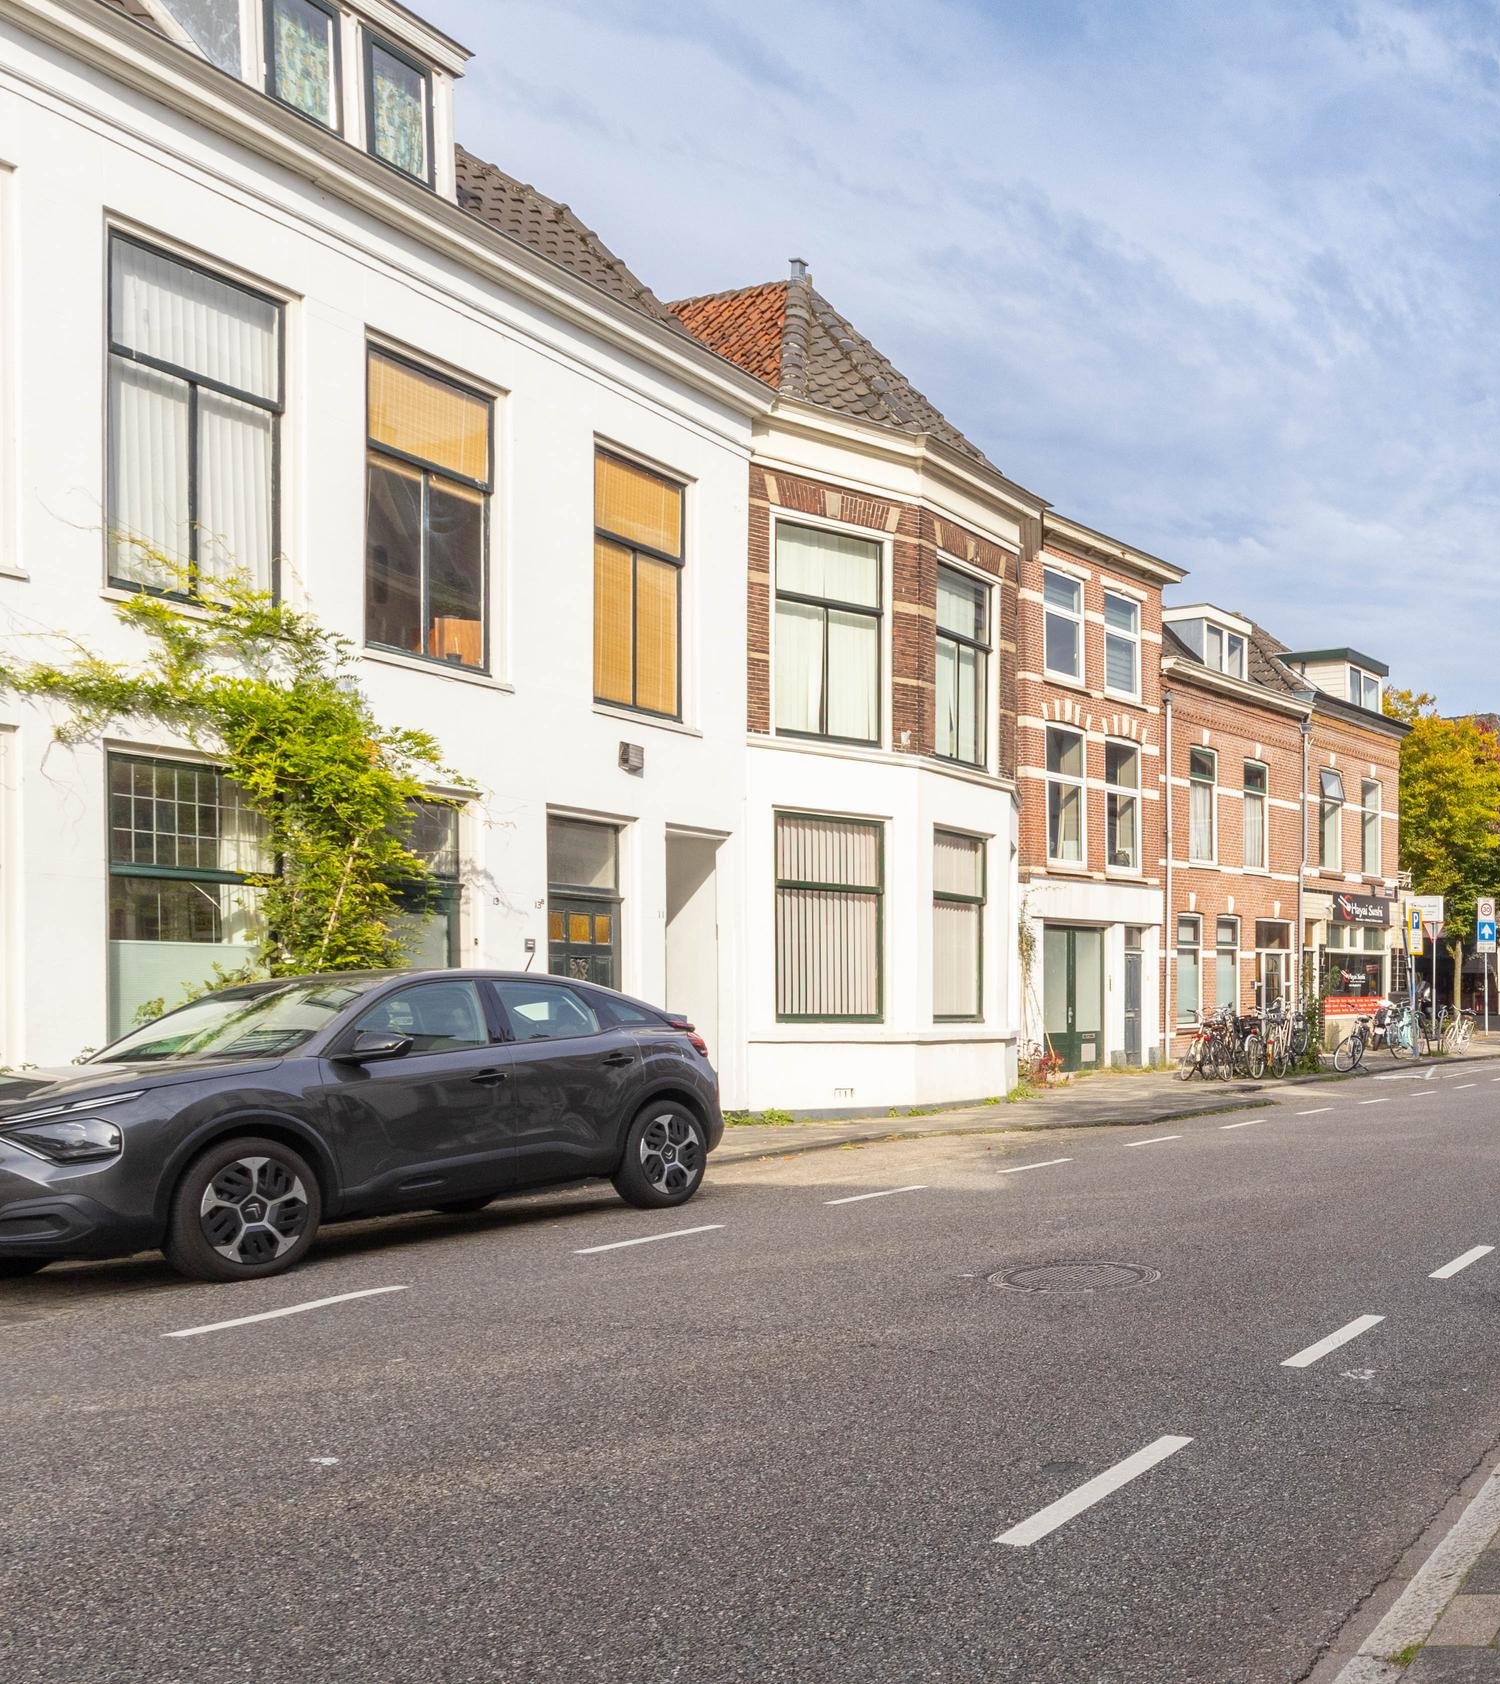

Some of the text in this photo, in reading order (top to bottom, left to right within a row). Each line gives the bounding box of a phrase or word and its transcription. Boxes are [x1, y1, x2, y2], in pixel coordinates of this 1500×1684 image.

[1351, 902, 1383, 918] Hayai Sushi
[1413, 912, 1419, 929] P
